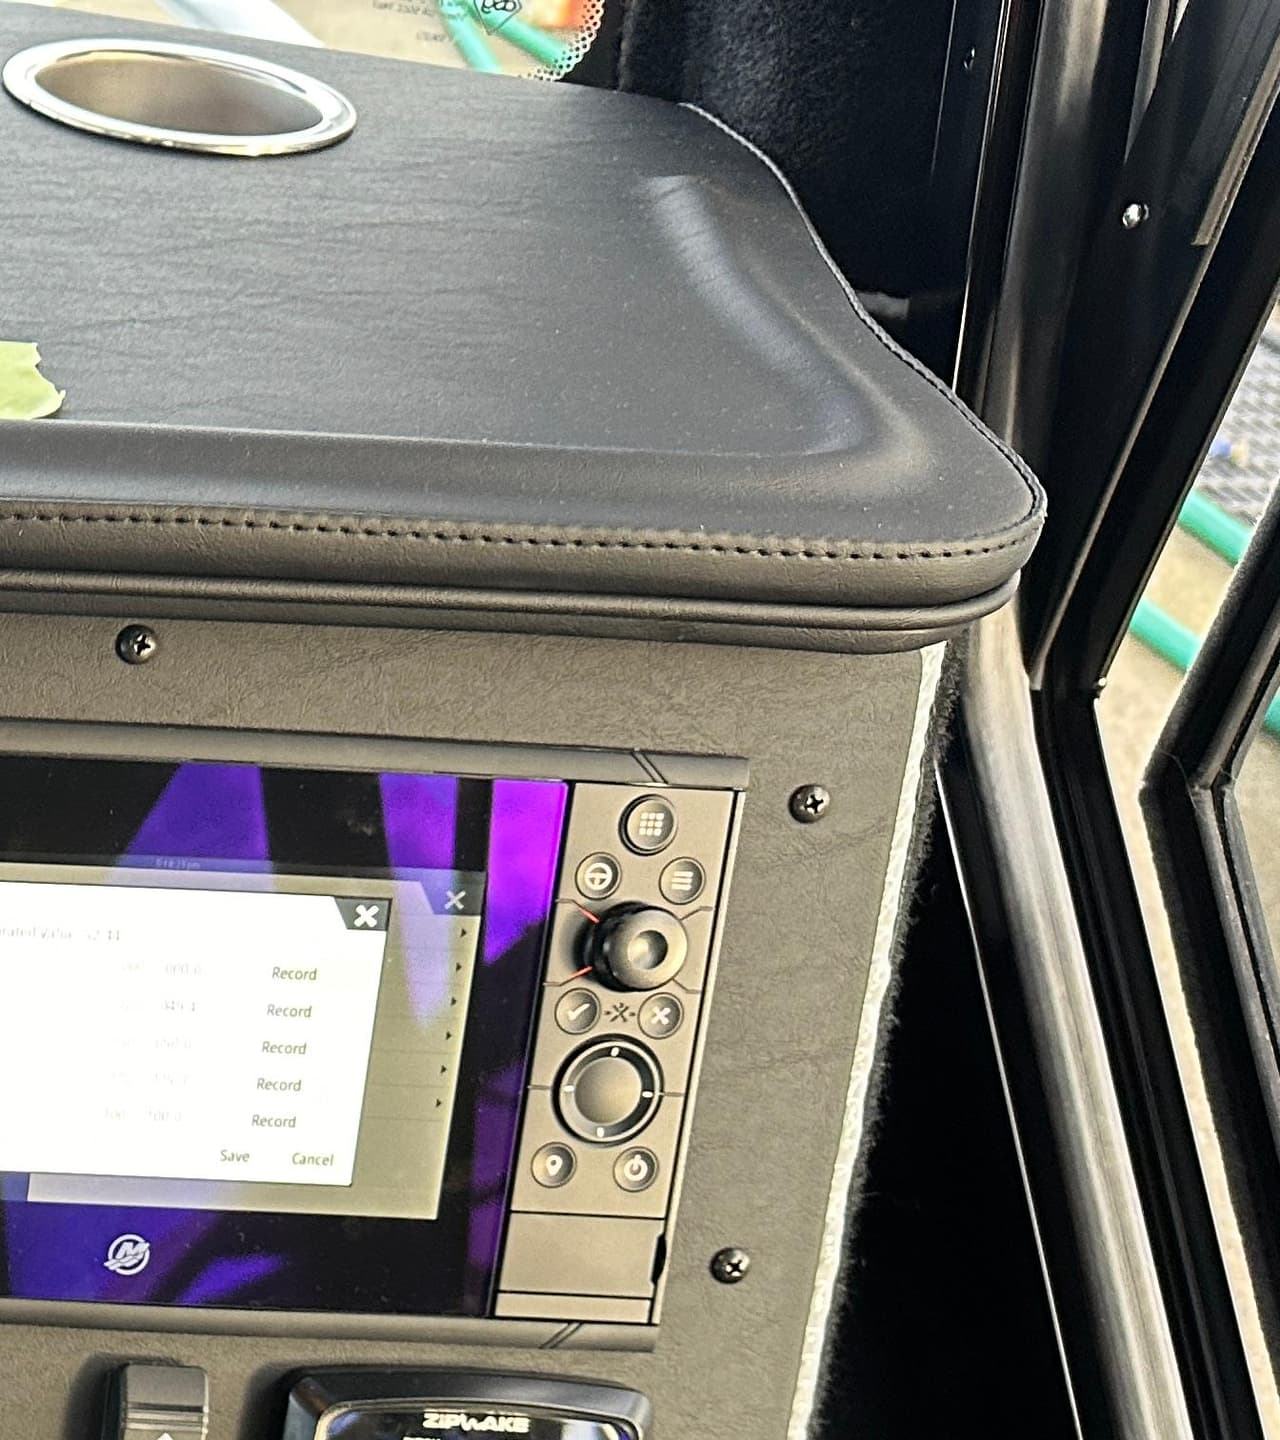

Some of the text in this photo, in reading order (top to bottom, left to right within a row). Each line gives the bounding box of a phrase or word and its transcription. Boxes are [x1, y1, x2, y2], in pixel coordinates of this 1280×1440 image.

[272, 966, 317, 981] Record
[267, 1003, 312, 1019] Record
[262, 1040, 307, 1056] Record
[256, 1077, 302, 1093] Record
[251, 1114, 297, 1130] Record
[220, 1149, 334, 1167] Save Cancel
[422, 1413, 530, 1433] ZIPWAKE
